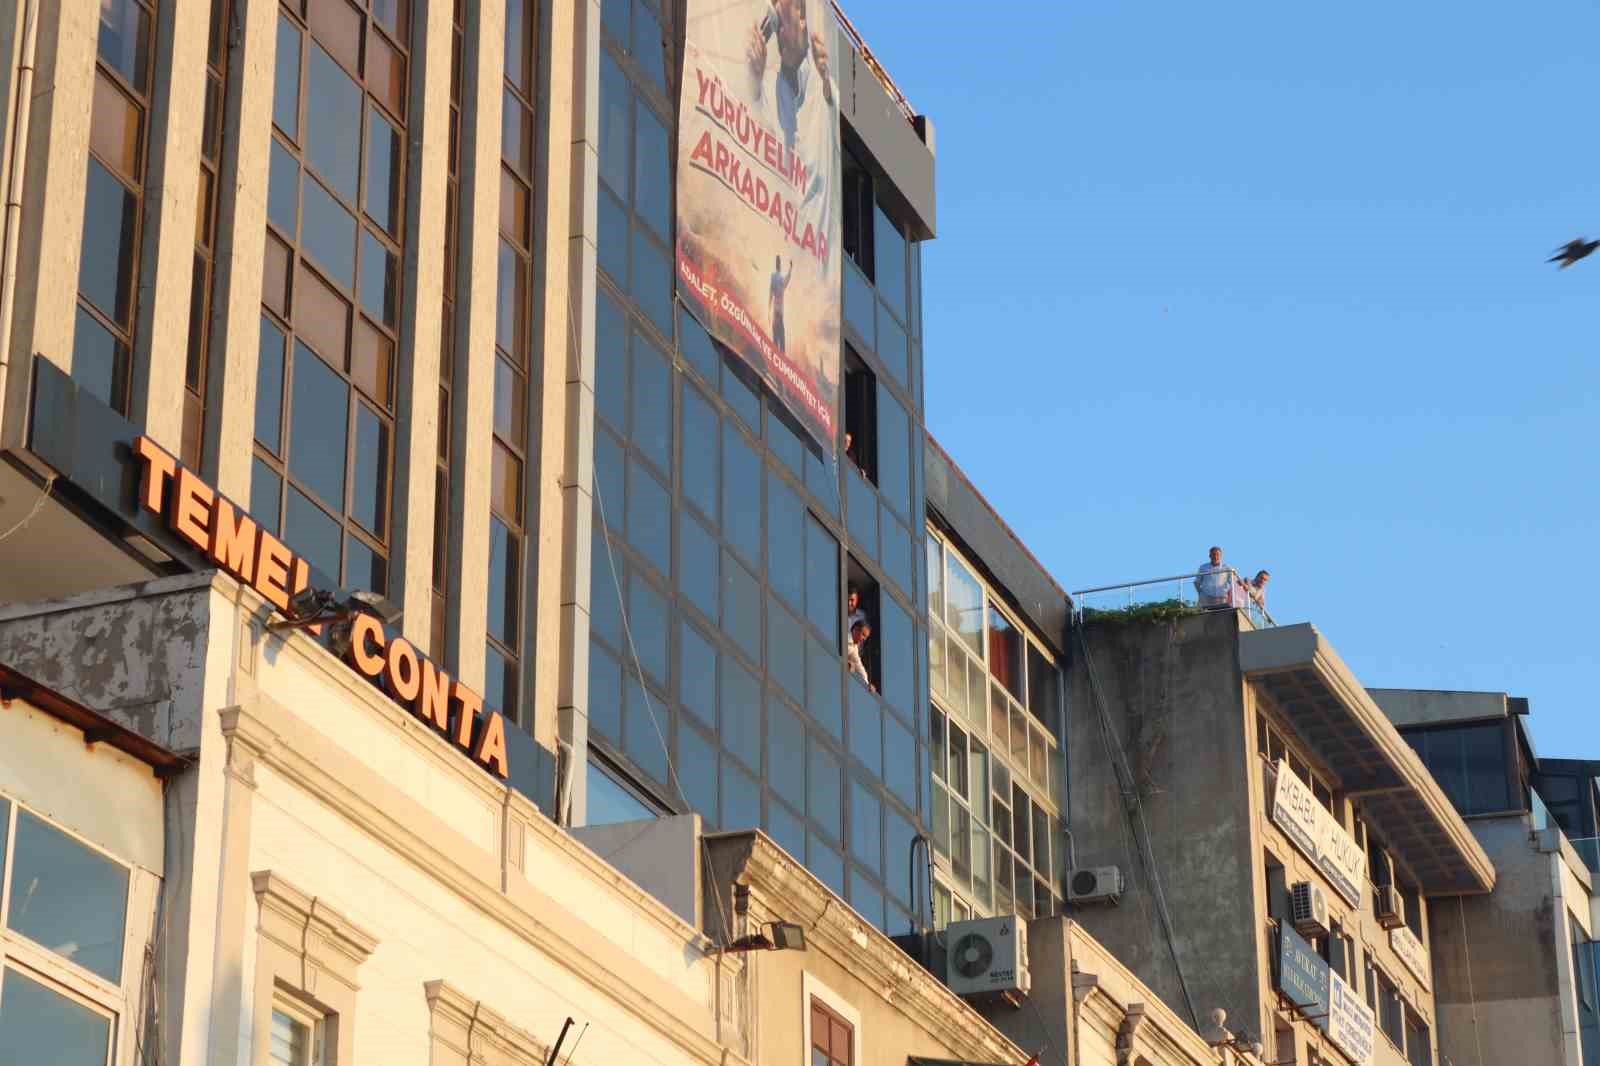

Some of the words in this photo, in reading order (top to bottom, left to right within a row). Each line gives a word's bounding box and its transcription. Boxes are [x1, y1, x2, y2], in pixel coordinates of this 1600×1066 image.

[690, 130, 828, 260] ARKADAŞLAR
[695, 68, 807, 195] YÜRÜYELİM
[349, 611, 510, 779] CONTA
[1279, 772, 1315, 826] AKBABA
[1331, 831, 1361, 880] HUKUK
